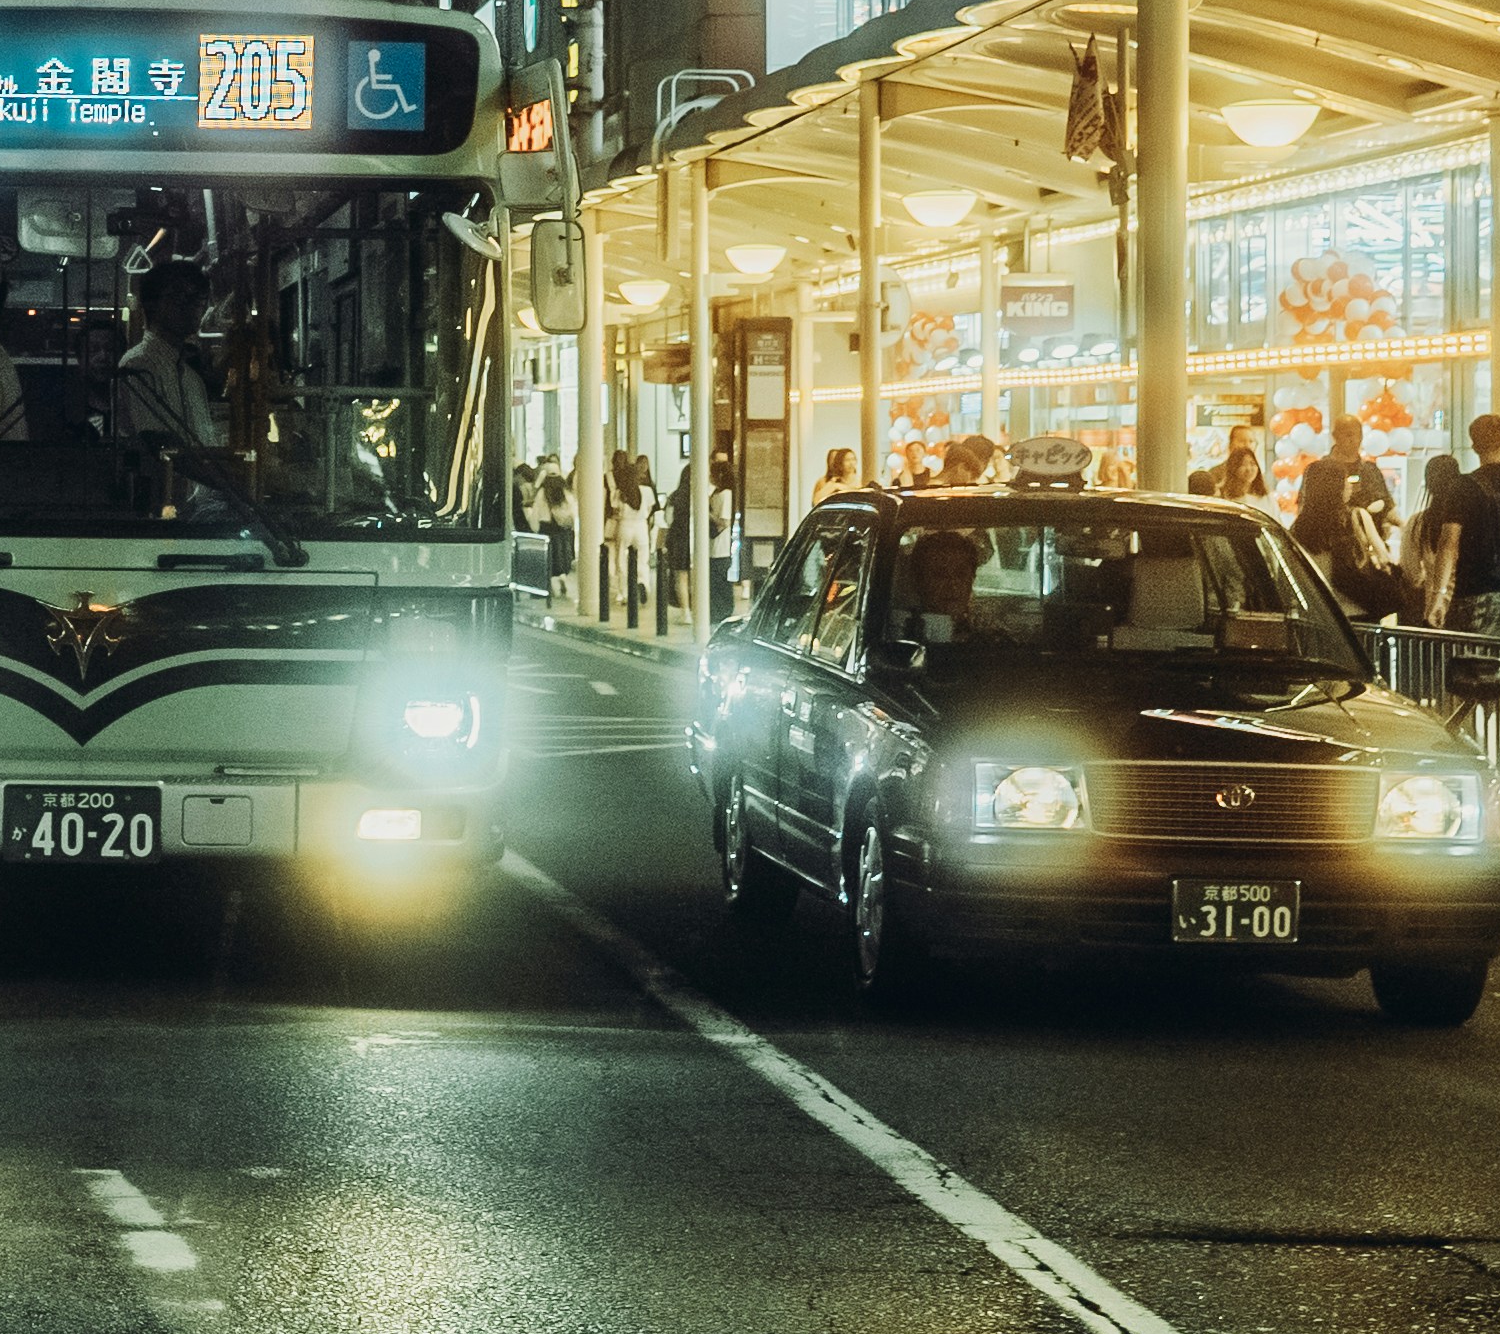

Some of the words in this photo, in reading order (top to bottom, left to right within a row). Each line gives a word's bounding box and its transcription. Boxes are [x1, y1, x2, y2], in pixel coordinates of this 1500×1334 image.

[36, 57, 186, 94] 金閣寺
[203, 39, 308, 123] 205
[66, 97, 146, 124] Temple
[1006, 301, 1069, 317] KING
[31, 812, 153, 858] 40-20
[1200, 905, 1291, 938] 31-00
